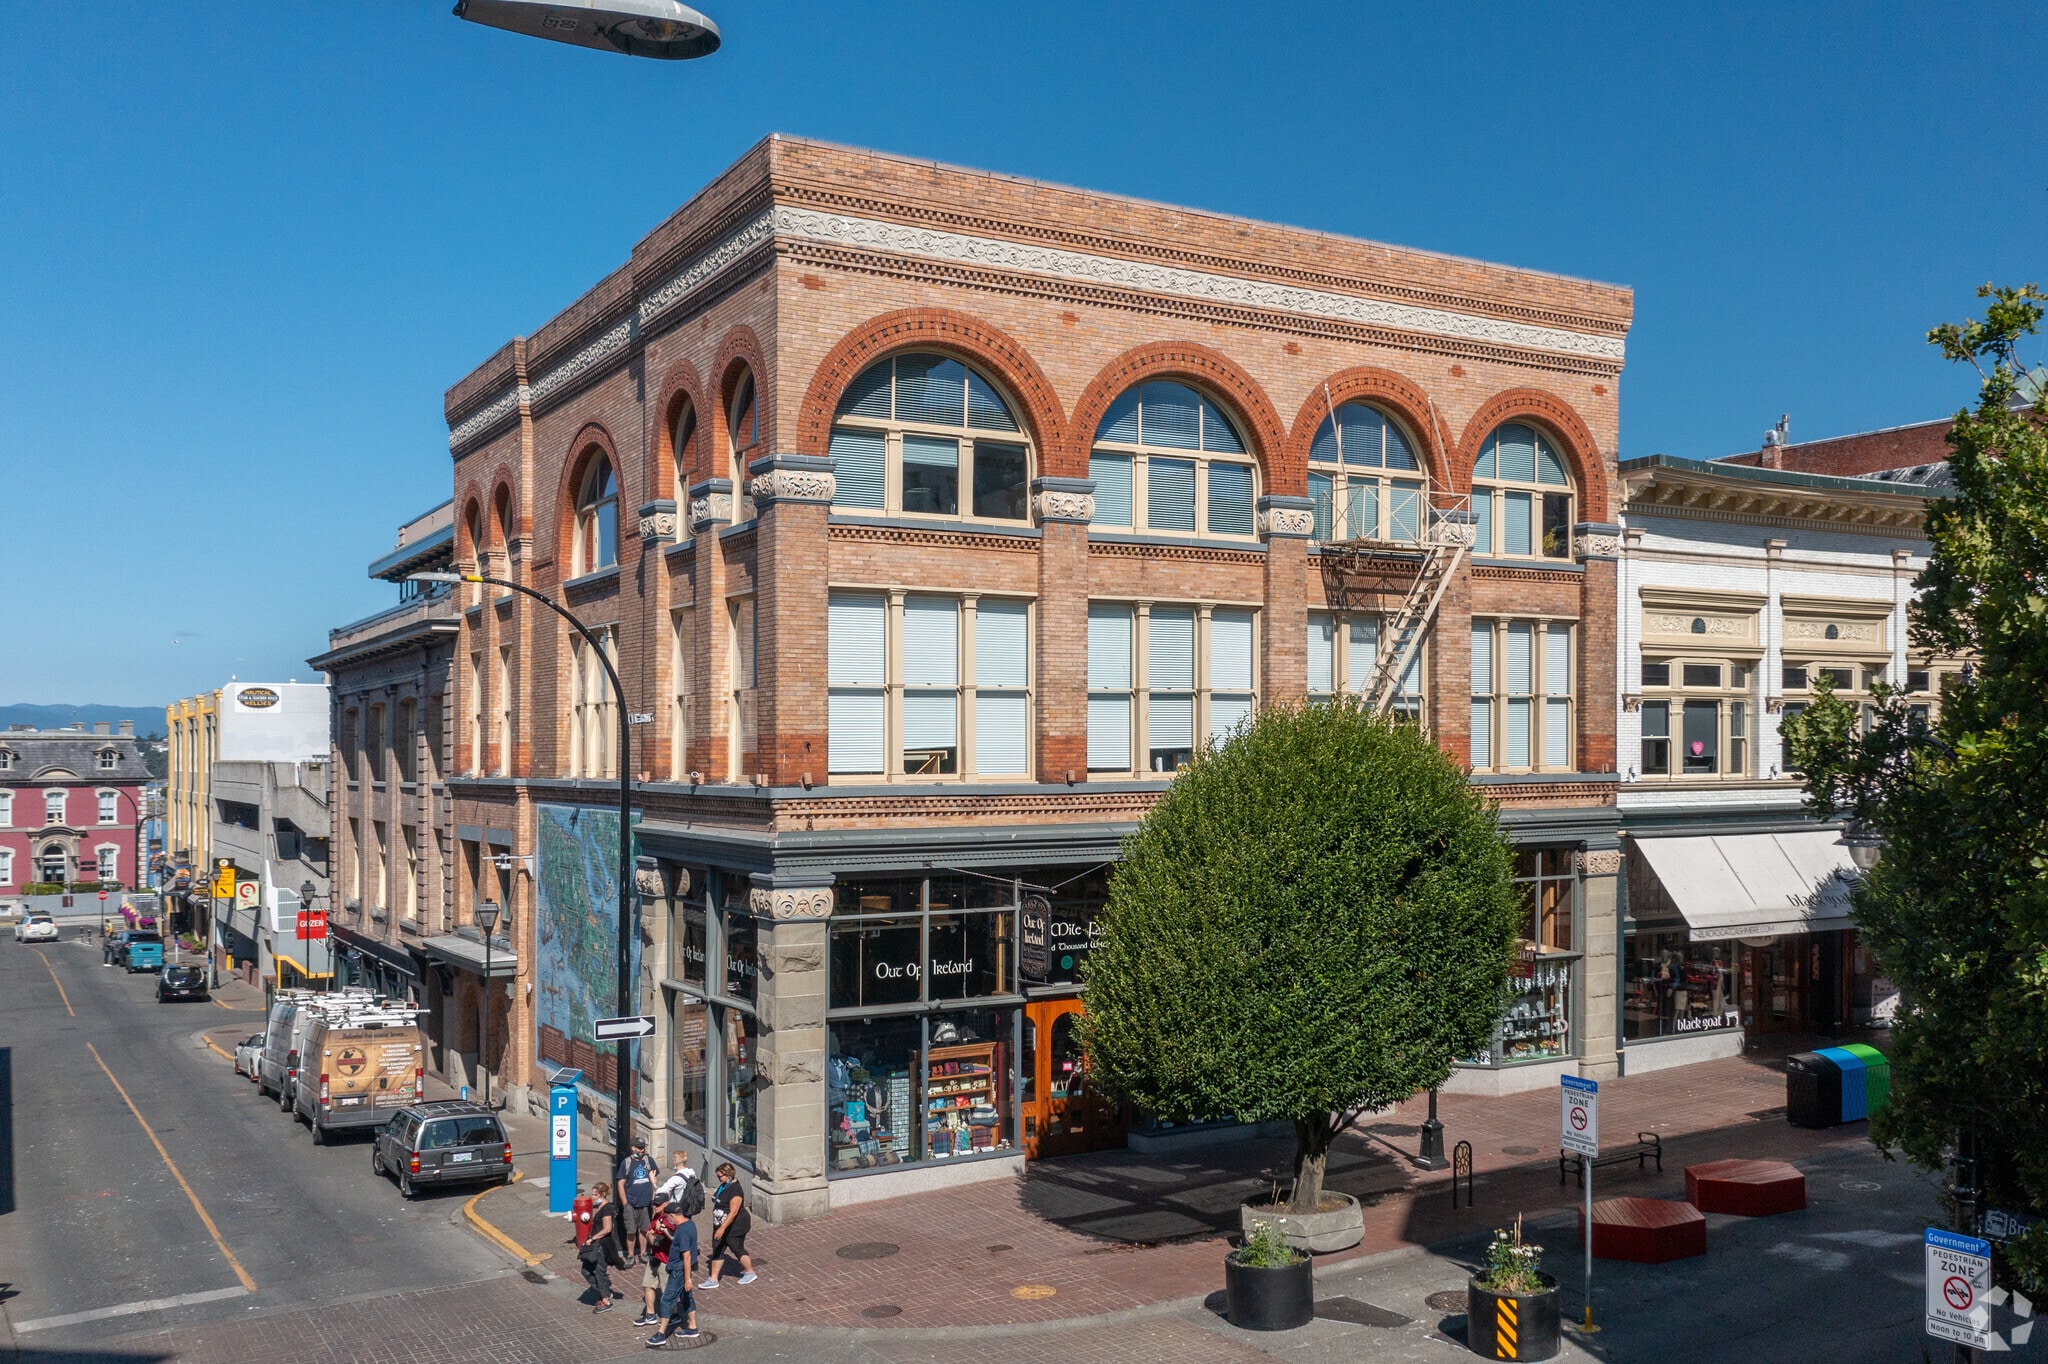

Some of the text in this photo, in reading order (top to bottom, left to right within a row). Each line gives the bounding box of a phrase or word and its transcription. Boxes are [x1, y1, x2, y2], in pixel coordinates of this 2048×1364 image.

[876, 962, 903, 979] Out
[932, 958, 973, 975] Ireland
[1678, 1015, 1722, 1031] black goat
[558, 1097, 568, 1108] P
[1564, 1089, 1594, 1100] PEDESTRIAN
[1569, 1097, 1588, 1107] ZONE
[1928, 1232, 1979, 1253] Government
[1933, 1250, 1983, 1268] PEDESTRIAN
[1941, 1260, 1975, 1278] ZONE
[1936, 1308, 1980, 1326] No Vehicles
[1930, 1322, 1949, 1334] Noon
[1952, 1328, 1960, 1337] to
[1963, 1332, 1971, 1340] 10
